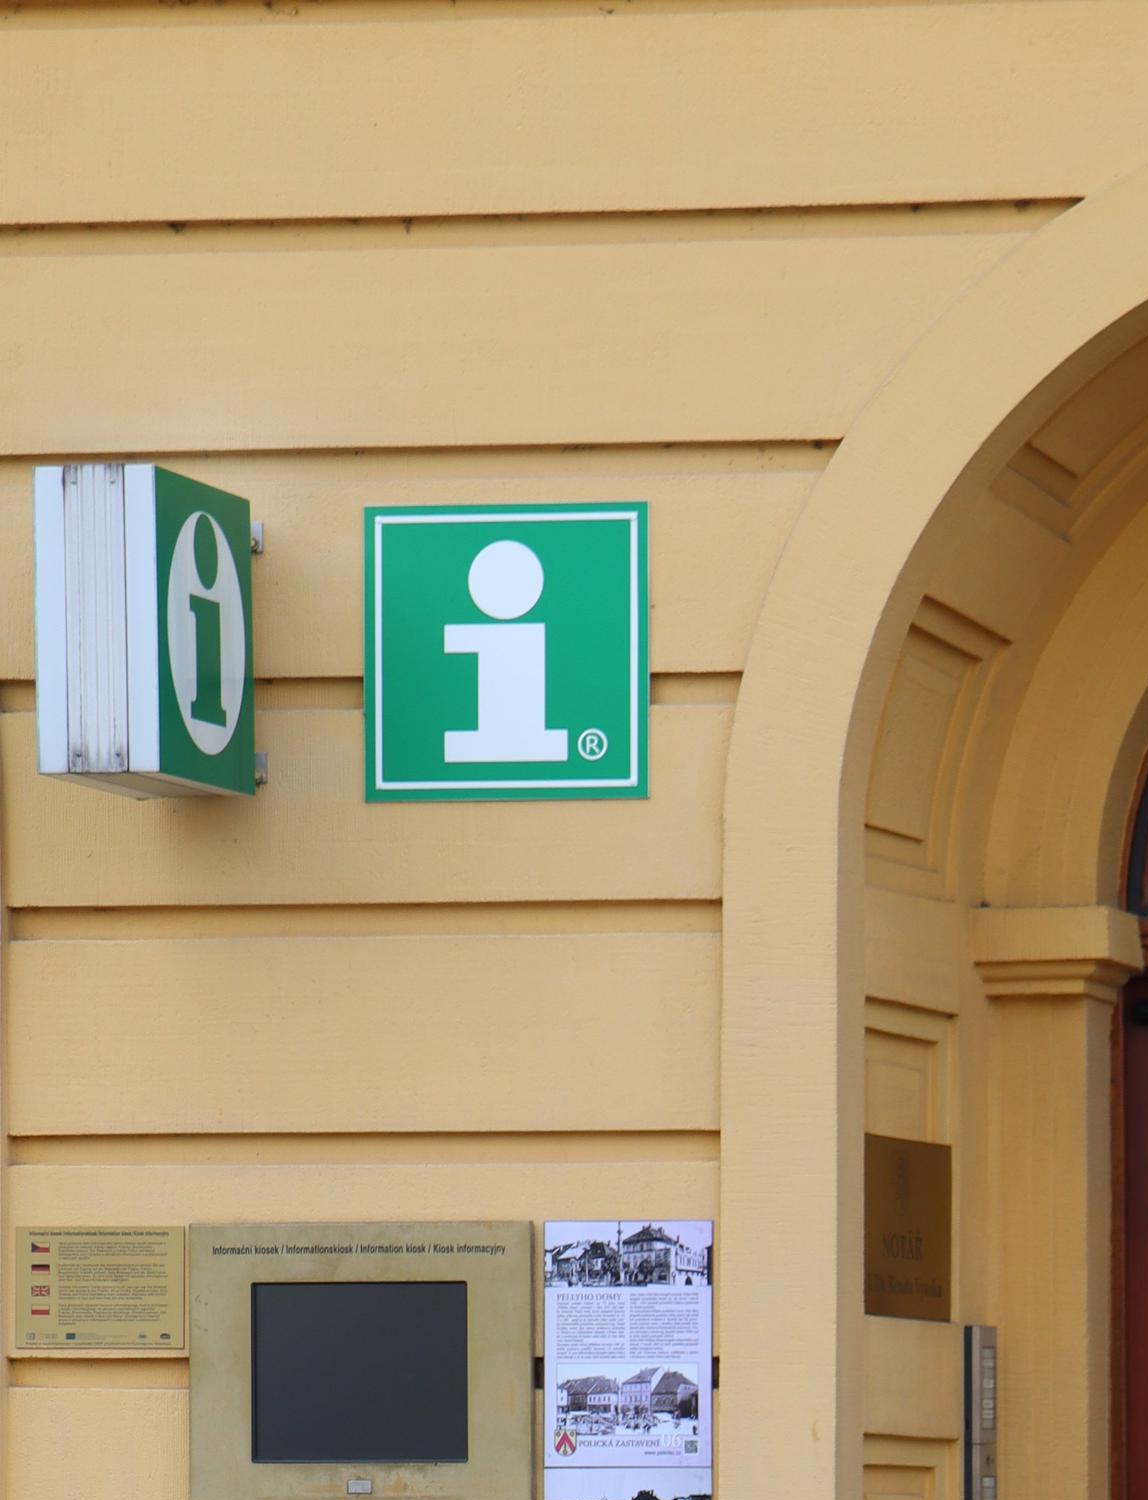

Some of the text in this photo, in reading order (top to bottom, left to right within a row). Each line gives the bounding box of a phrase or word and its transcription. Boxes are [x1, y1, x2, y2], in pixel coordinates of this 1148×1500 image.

[212, 1244, 253, 1255] Informační
[254, 1244, 279, 1255] kiosek
[285, 1243, 353, 1254] Informationskiosk
[360, 1243, 403, 1254] Information
[405, 1243, 426, 1254] kiosk
[433, 1243, 455, 1254] Kiosk
[456, 1243, 506, 1255] informacyjny
[579, 1438, 613, 1448] POLICKÁ
[615, 1438, 660, 1448] ZASTAVENÍ
